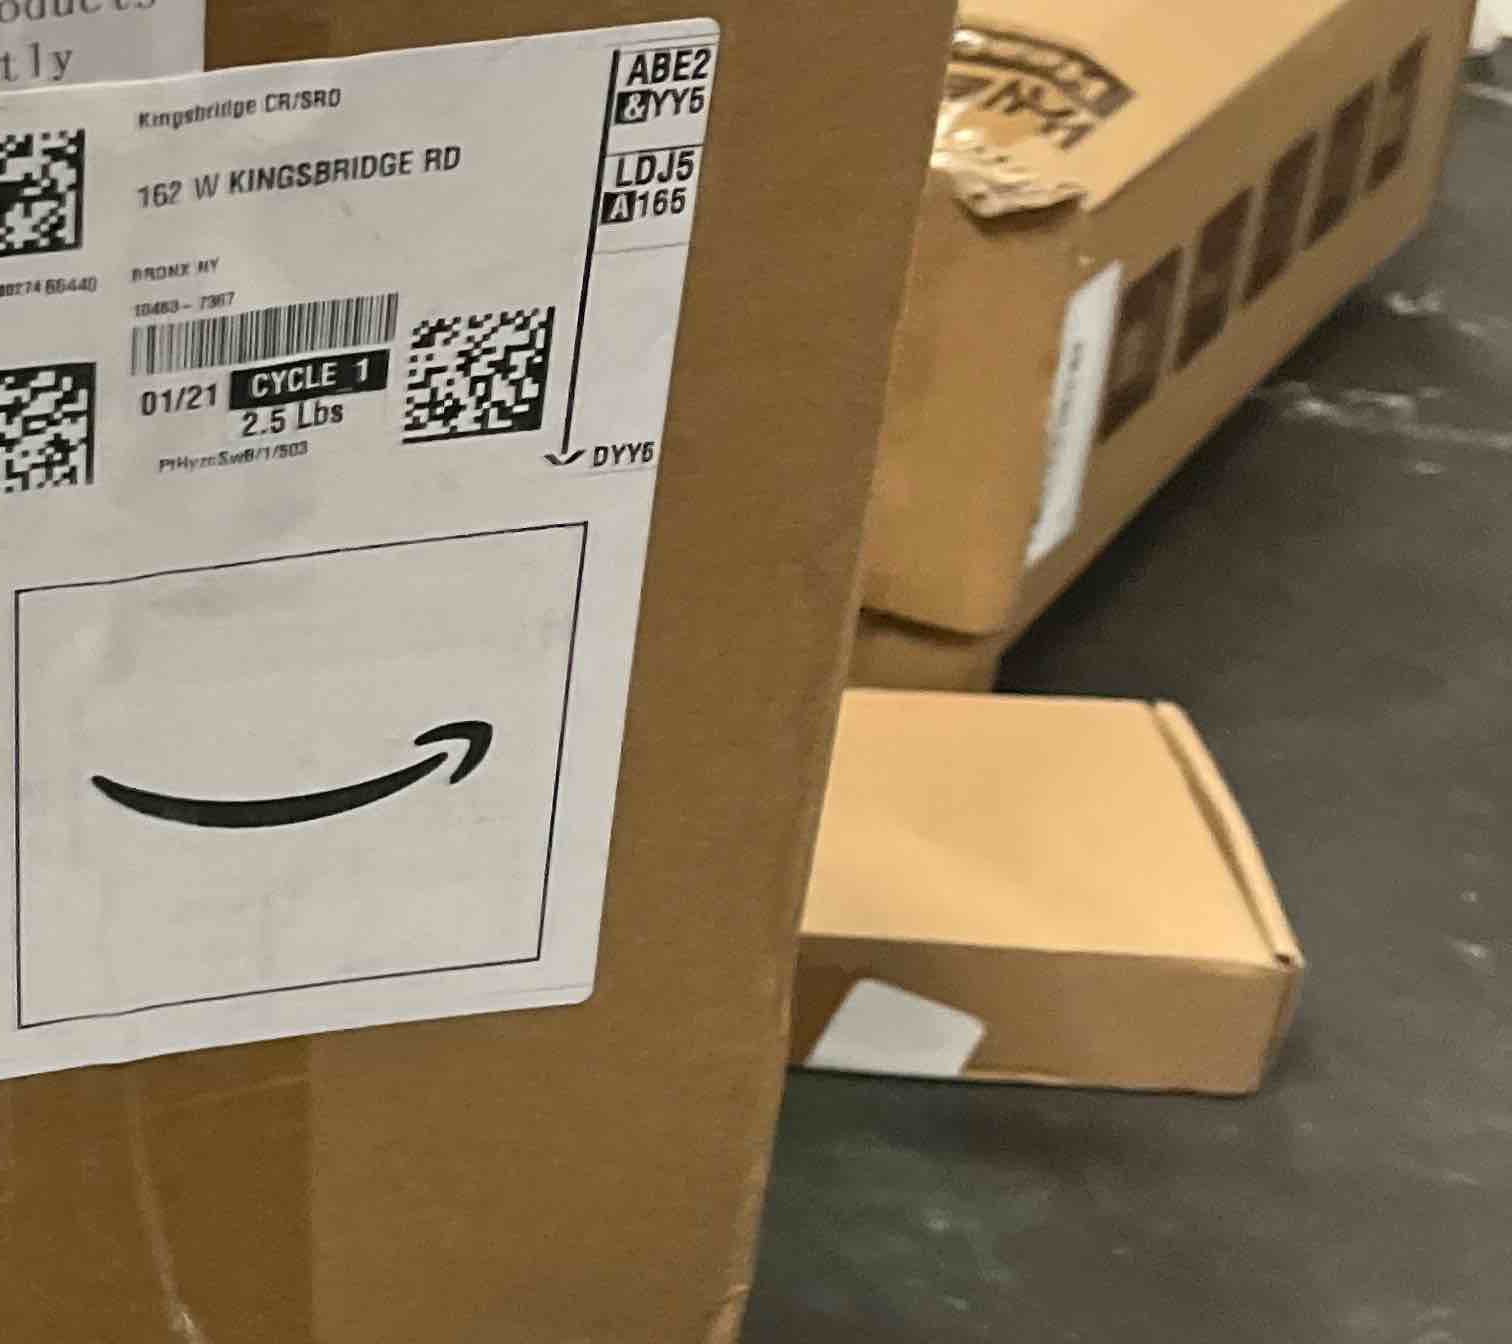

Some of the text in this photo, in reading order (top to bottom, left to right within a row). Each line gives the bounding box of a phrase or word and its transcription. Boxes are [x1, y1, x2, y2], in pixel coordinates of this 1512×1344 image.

[626, 48, 712, 86] ABE2
[138, 97, 257, 130] Kingsbridge
[137, 145, 462, 209] 162 W KINGSBRIDGE RD
[615, 150, 695, 188] LDJ5
[140, 382, 218, 417] 01/21
[241, 400, 345, 438] 2.5 Lbs
